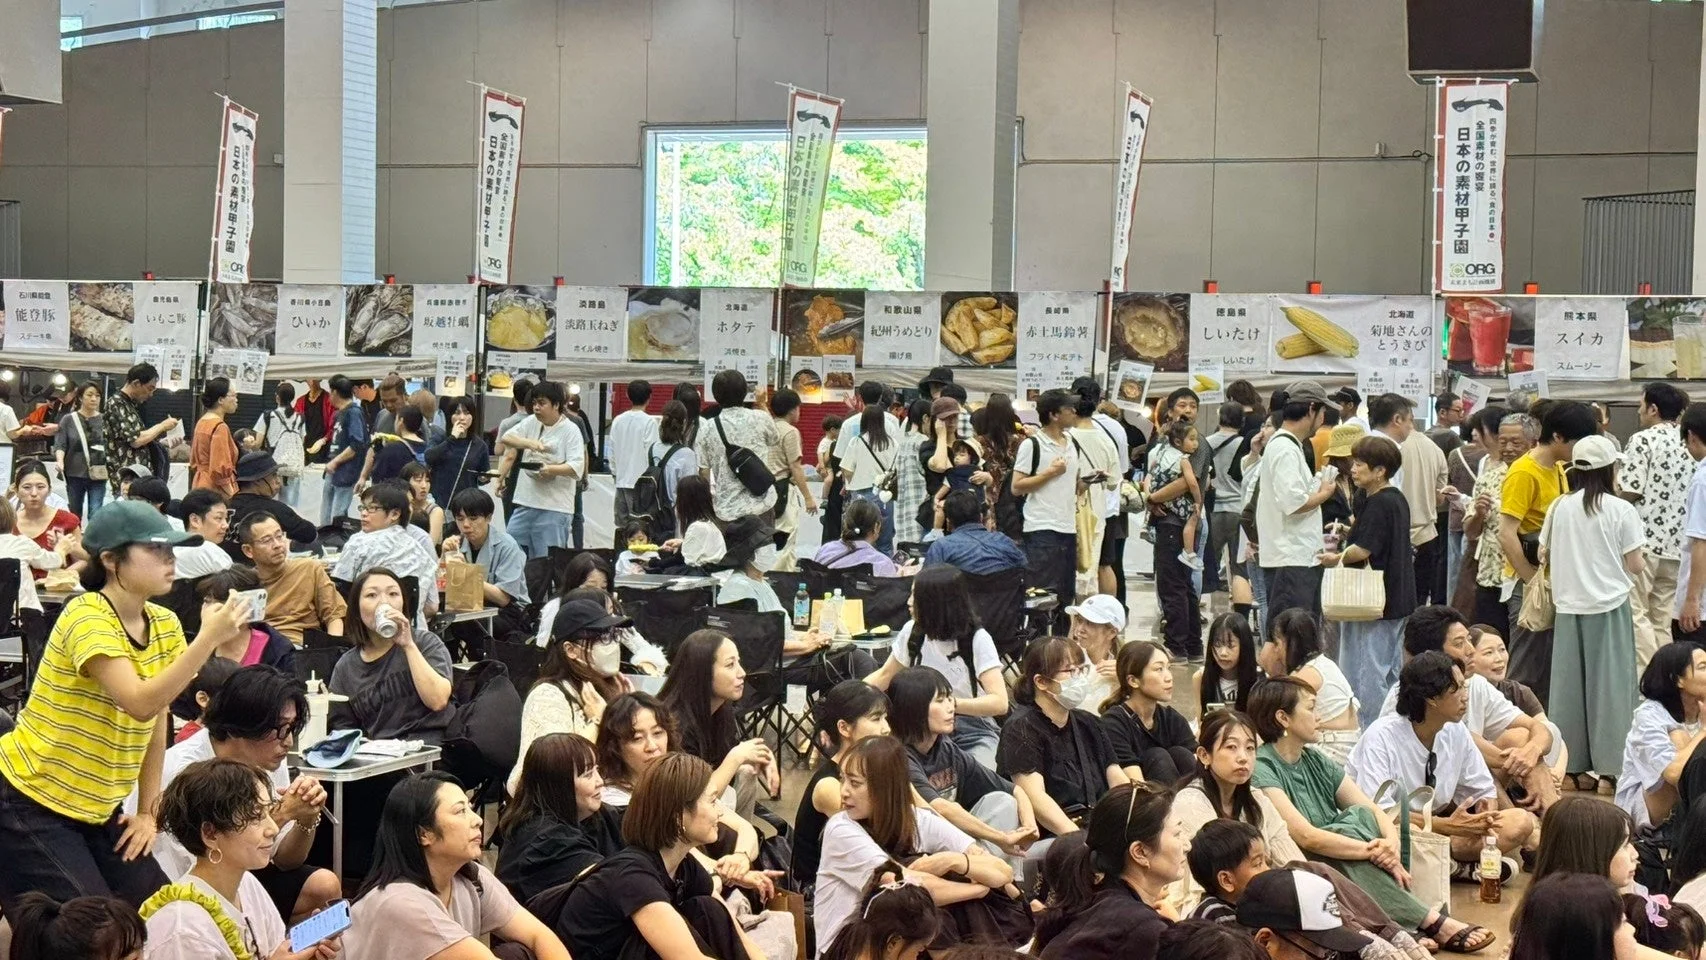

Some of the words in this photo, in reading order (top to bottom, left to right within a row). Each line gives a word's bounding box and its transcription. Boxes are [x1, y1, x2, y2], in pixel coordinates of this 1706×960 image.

[483, 135, 498, 248] 日本の素材甲子園
[785, 135, 806, 252] 日本の素材甲子園
[1454, 127, 1471, 254] 日本の素材甲子園
[225, 146, 241, 253] 日本の素材甲子園
[1465, 263, 1495, 275] ORG
[579, 300, 606, 309] 淡路島
[725, 303, 748, 311] 北海道
[884, 305, 922, 315] 和歌山県
[15, 308, 56, 322] 能登豚
[146, 313, 187, 324] いもこ豚
[1216, 308, 1246, 317] 徳島県
[1389, 310, 1415, 318] 北海道
[1564, 312, 1597, 321] 熊本県
[291, 316, 331, 328] ひいか
[423, 316, 470, 328] 坂越牡蠣
[565, 319, 619, 332] 淡路玉ねぎ
[717, 321, 756, 333] ホタテ
[870, 325, 932, 337] 紀州うめどり
[1026, 326, 1088, 338] 赤土馬鈴薯
[1204, 327, 1260, 340] しいたけ
[1370, 325, 1432, 337] 菊地さんの
[1377, 339, 1427, 351] とうきび
[1555, 332, 1604, 346] スイカ
[1029, 353, 1084, 361] フライドポテト
[1556, 361, 1602, 371] スムージー
